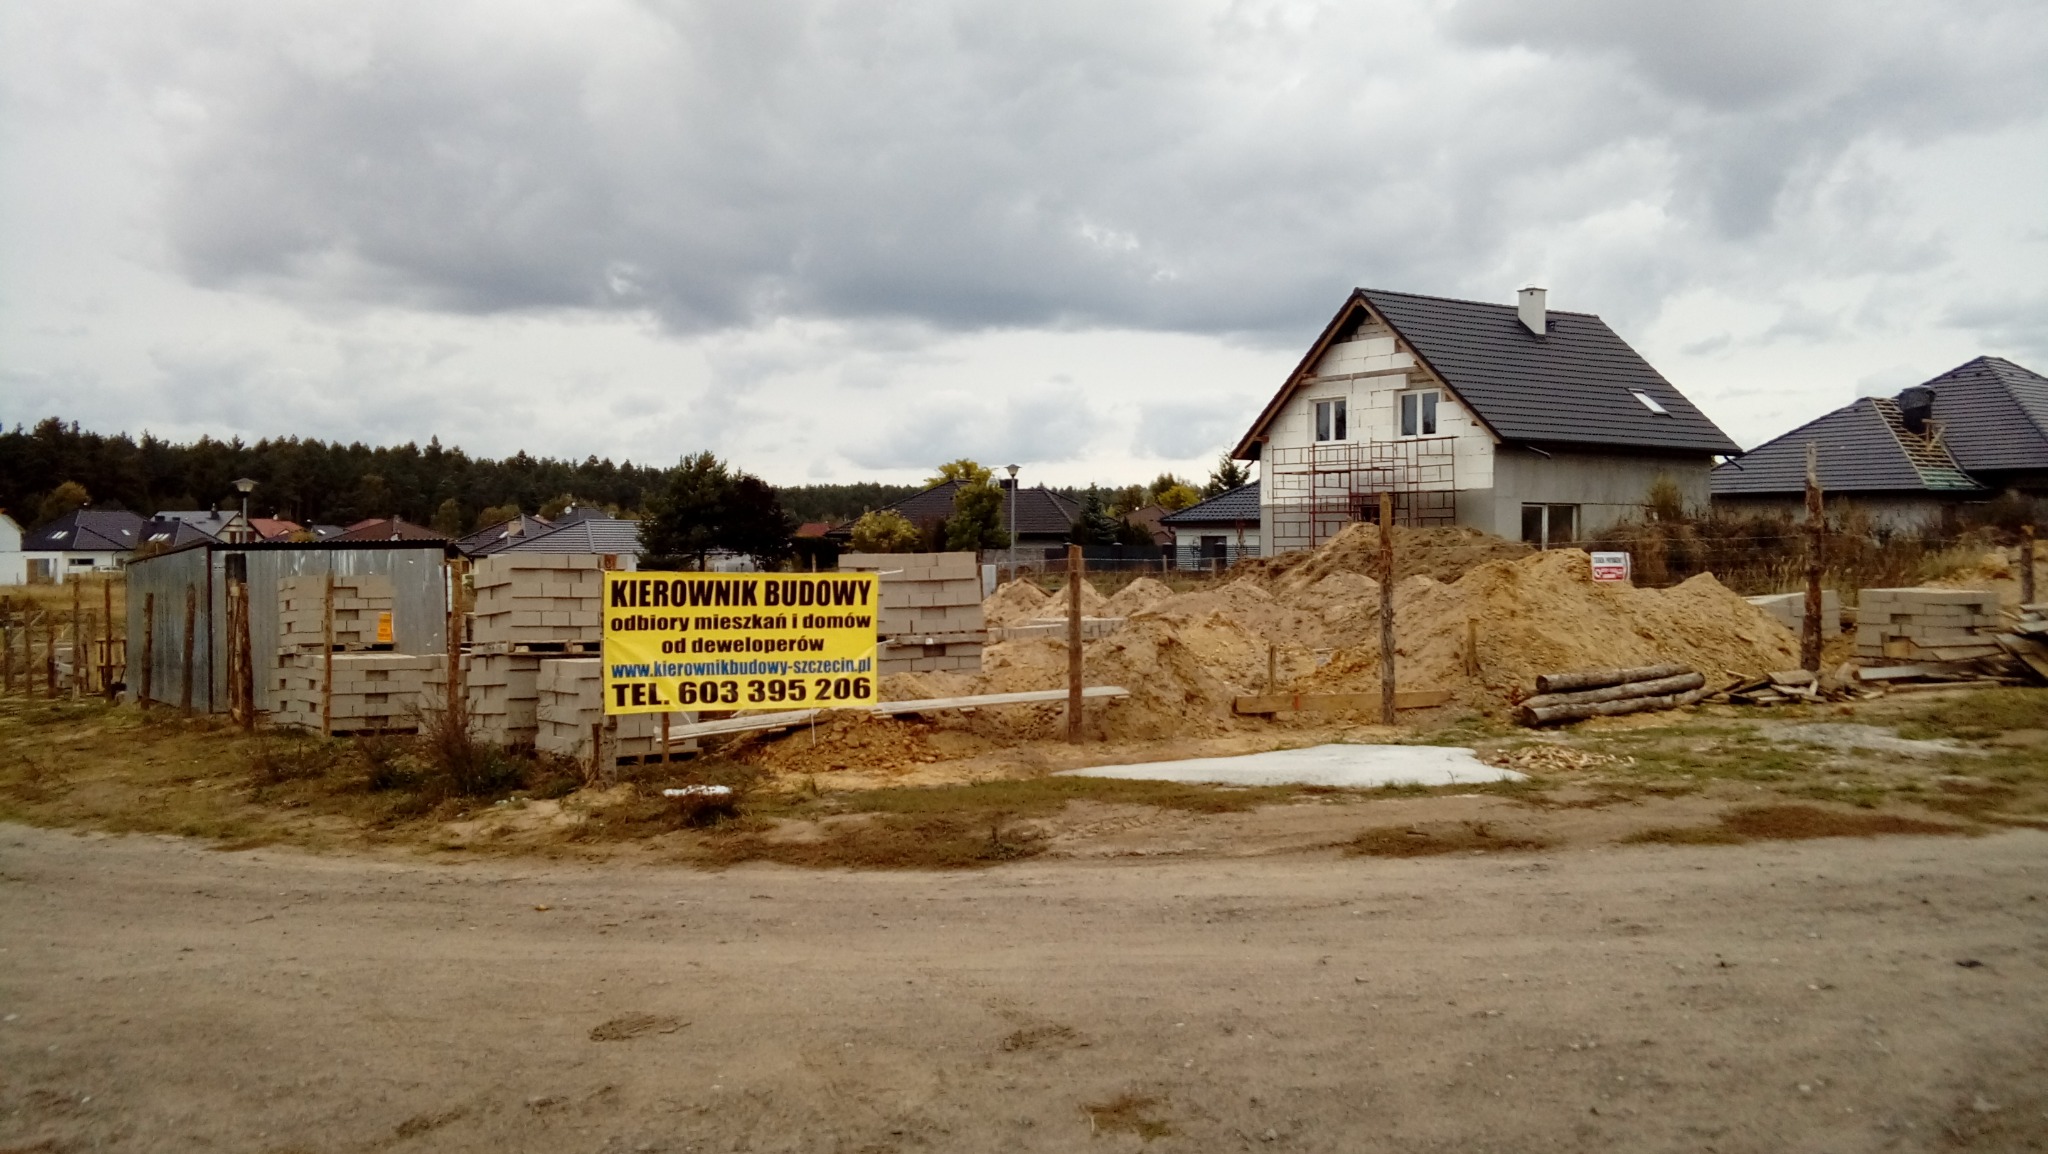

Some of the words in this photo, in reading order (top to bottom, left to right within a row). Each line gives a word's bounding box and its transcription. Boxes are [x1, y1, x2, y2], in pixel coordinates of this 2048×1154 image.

[611, 580, 757, 607] KIEROWNIK
[764, 580, 871, 606] BUDOWY
[611, 615, 689, 632] odbiory
[695, 613, 786, 630] mieszkań
[792, 614, 797, 628] i
[803, 612, 871, 628] domów
[662, 638, 686, 654] od
[692, 637, 824, 653] deweloperów
[612, 657, 871, 678] www.kierownikbudowy-szczecin.pl
[612, 683, 670, 706] TEL.
[679, 681, 739, 704] 603
[748, 680, 806, 702] 395
[815, 678, 871, 700] 206
